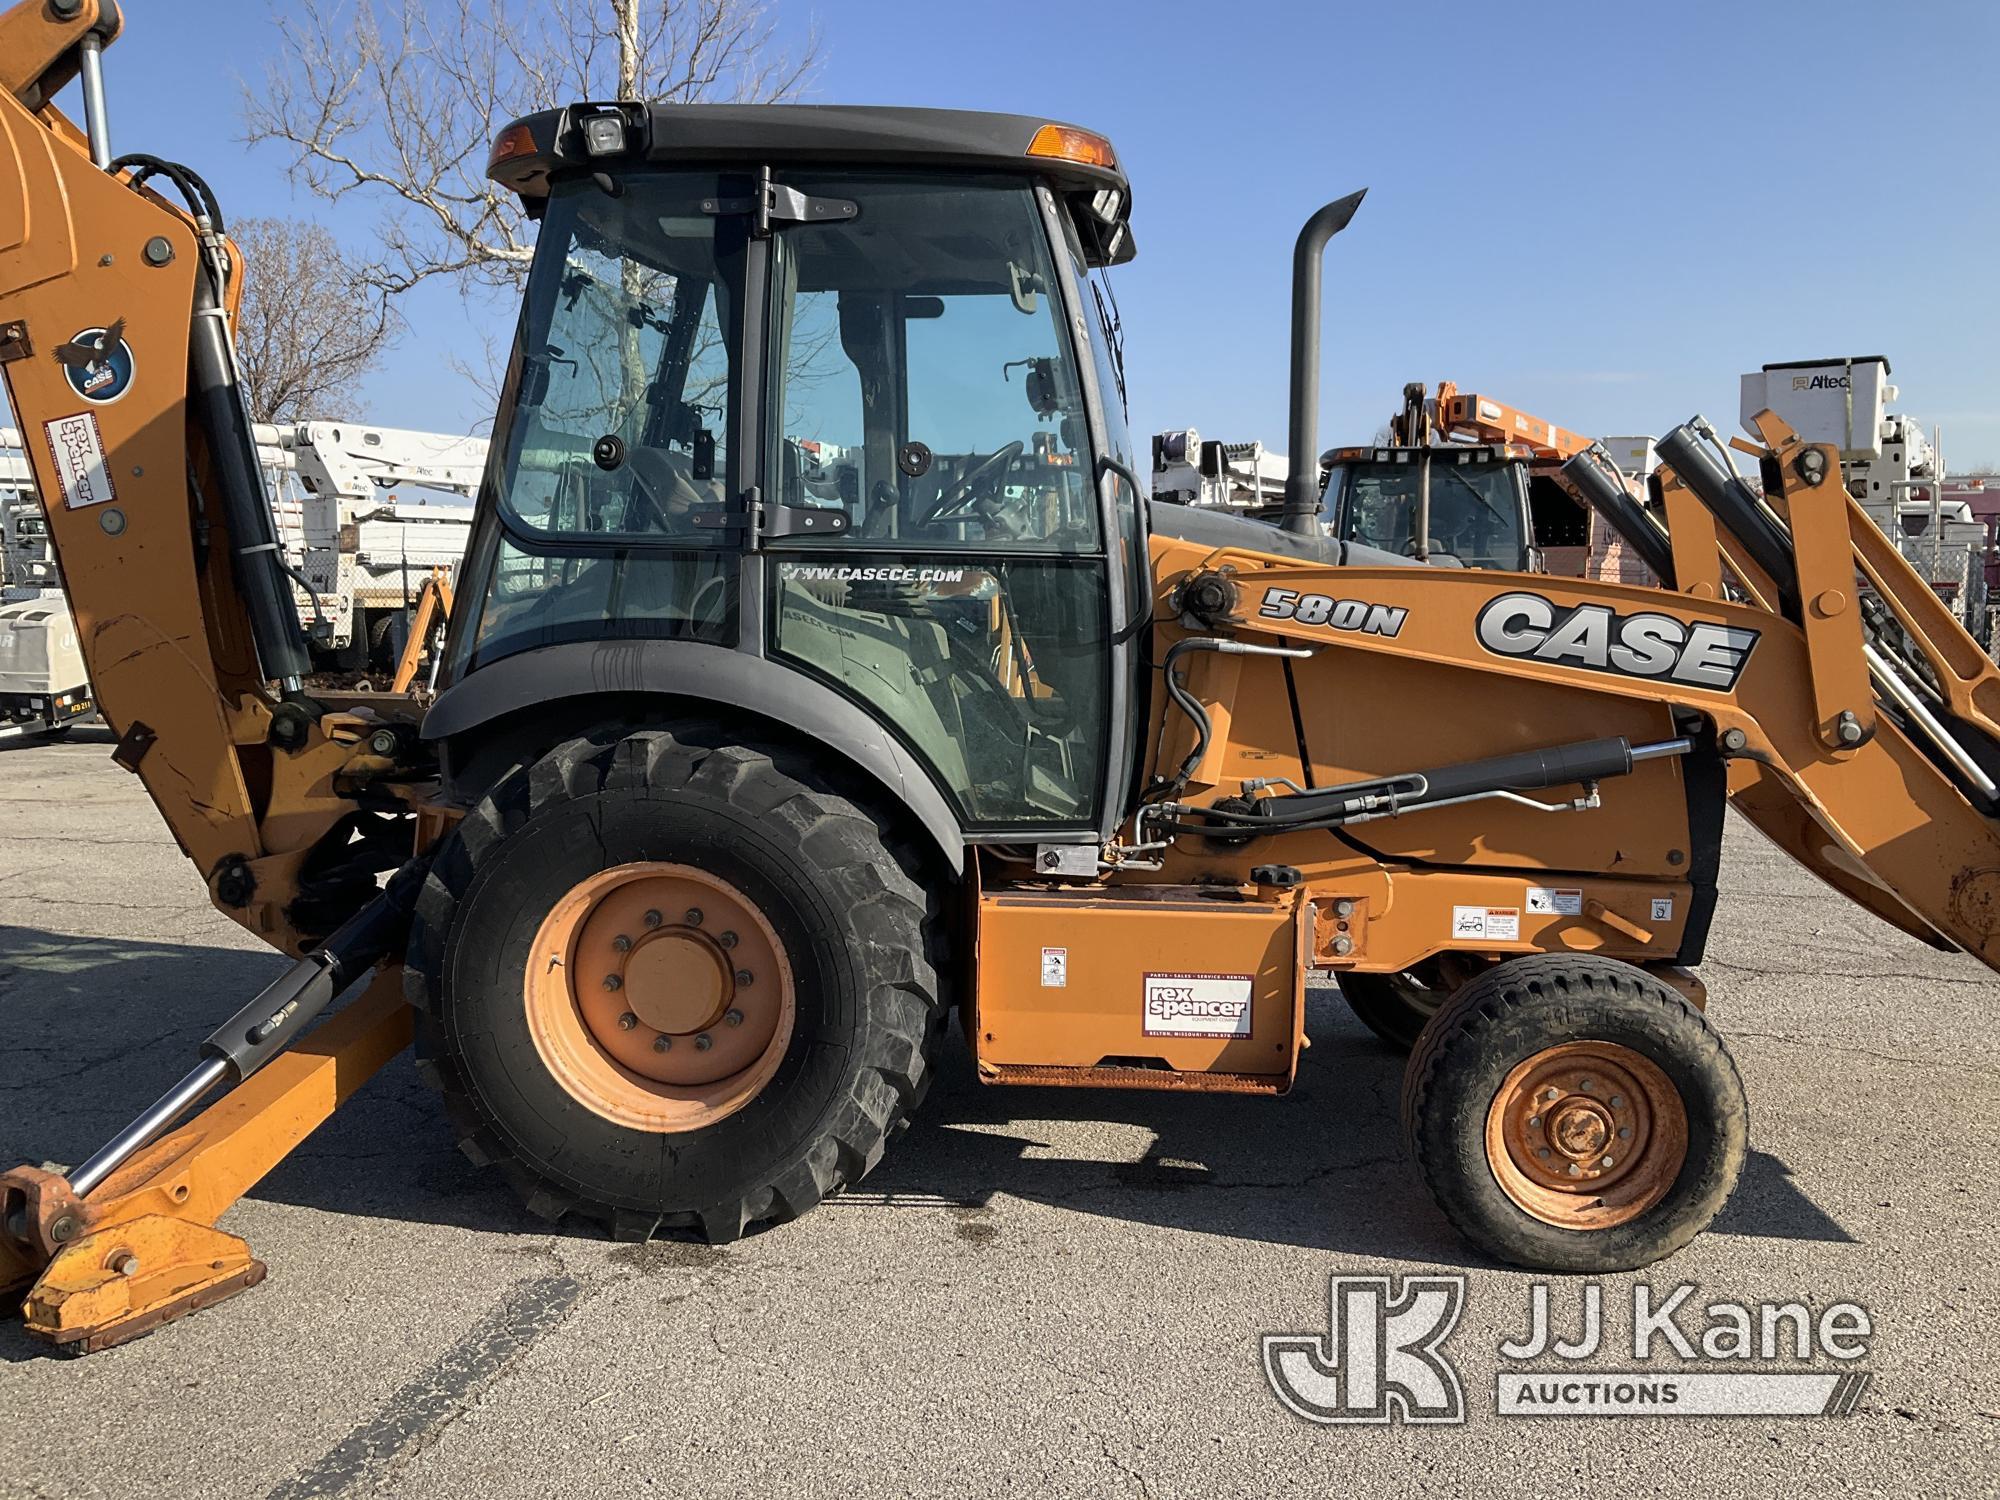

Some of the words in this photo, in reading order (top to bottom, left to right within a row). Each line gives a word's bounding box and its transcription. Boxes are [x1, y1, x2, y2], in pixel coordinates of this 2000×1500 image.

[83, 369, 113, 388] CASE
[1809, 375, 1850, 390] Altec
[73, 418, 93, 455] rex
[61, 421, 94, 502] spencer
[782, 566, 964, 583] WWW.CASECE.COM
[1259, 587, 1409, 638] 580N
[1476, 592, 1759, 692] CASE
[1150, 986, 1193, 1002] rex
[1149, 1000, 1247, 1020] spencer
